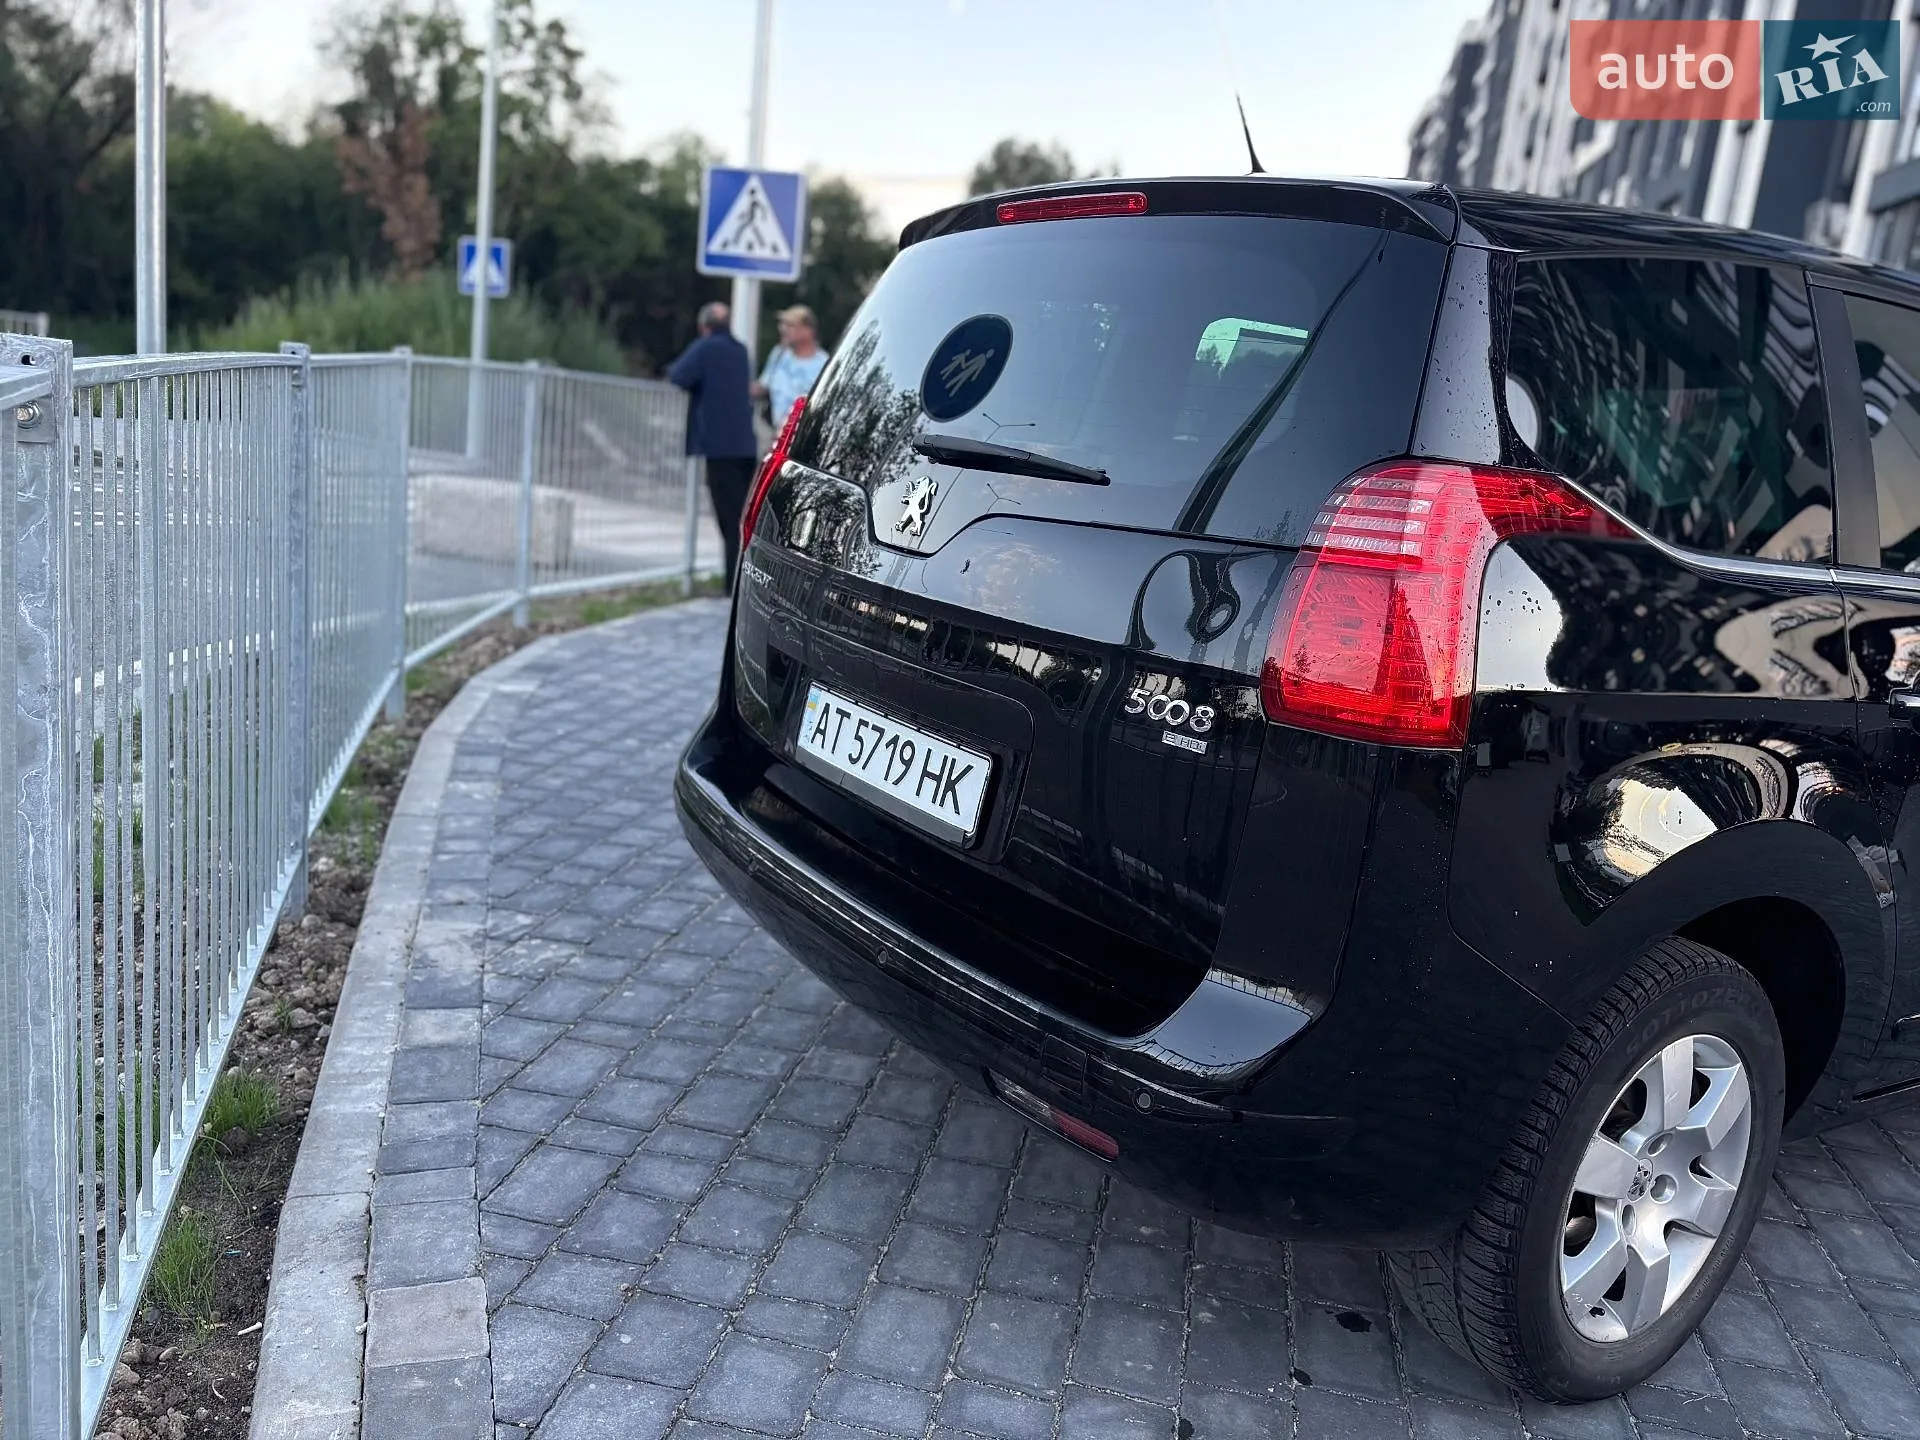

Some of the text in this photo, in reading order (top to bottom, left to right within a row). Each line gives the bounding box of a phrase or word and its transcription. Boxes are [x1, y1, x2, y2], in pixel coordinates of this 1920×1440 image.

[1124, 688, 1215, 733] 5008
[811, 702, 974, 816] AT 5719 HK
